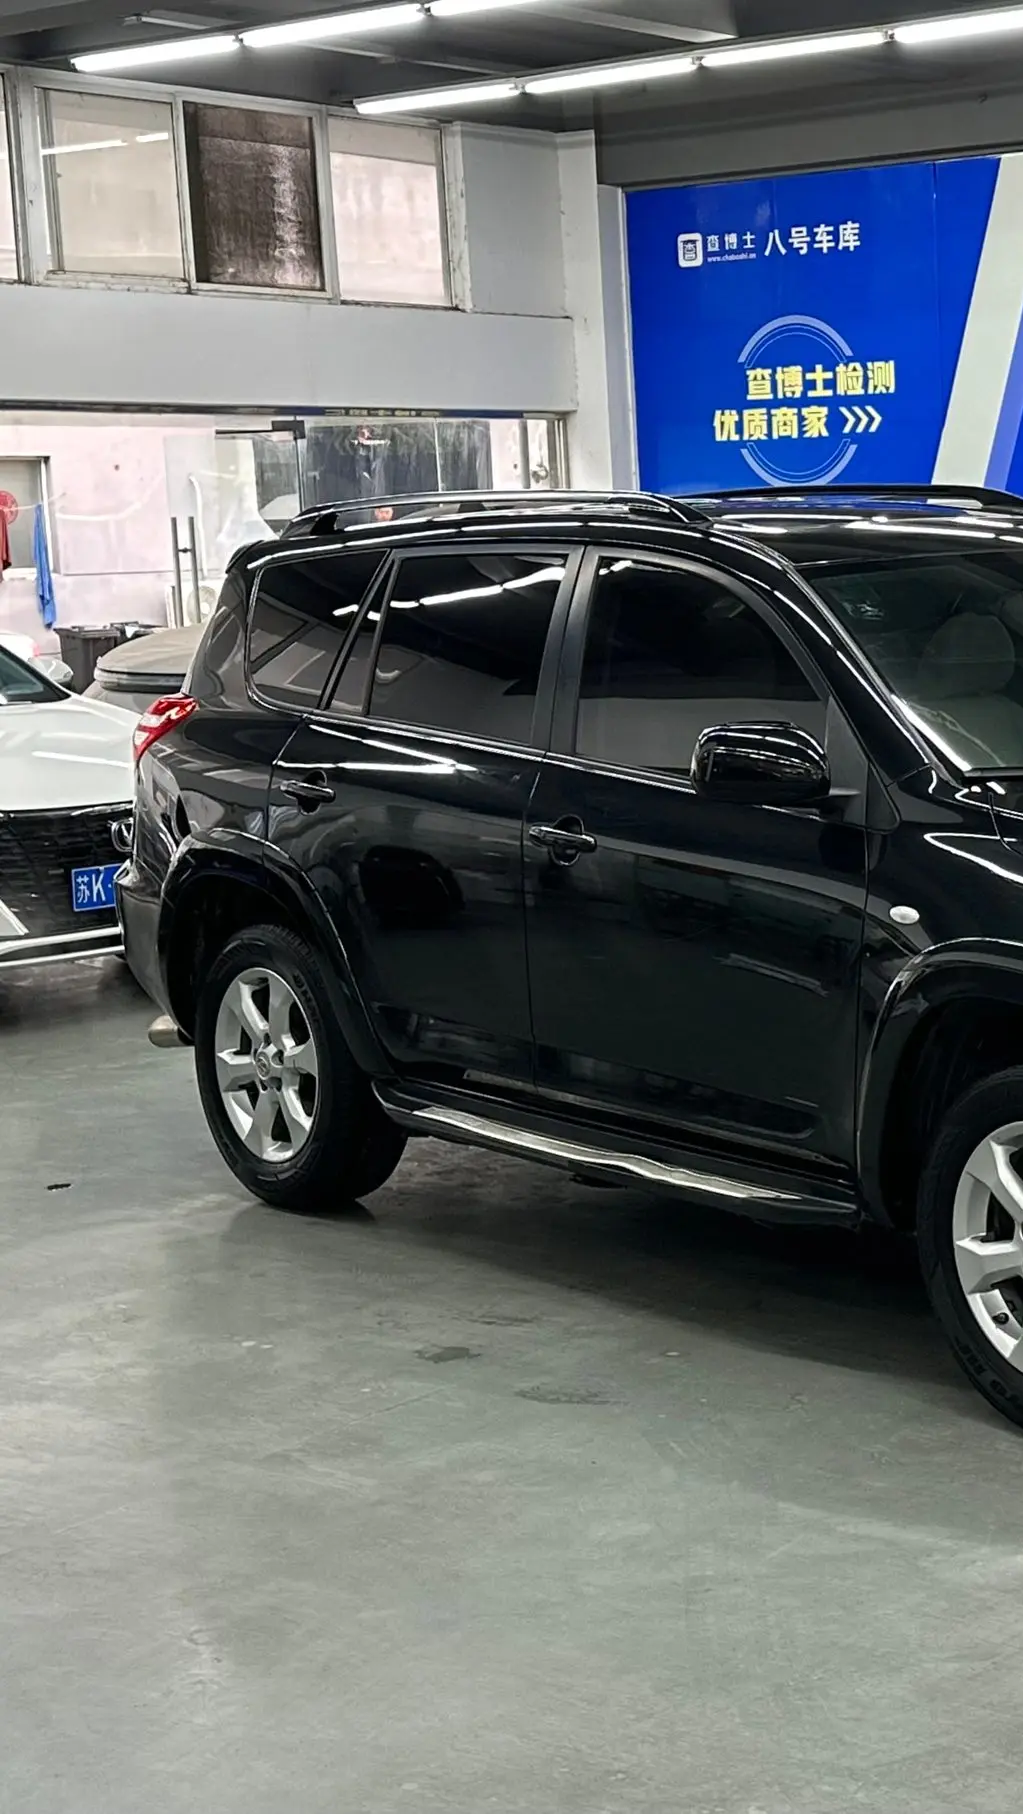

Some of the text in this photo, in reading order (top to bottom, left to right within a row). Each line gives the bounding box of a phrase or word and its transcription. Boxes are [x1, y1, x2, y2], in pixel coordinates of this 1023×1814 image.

[706, 220, 861, 257] 查博士 八号车库
[745, 360, 896, 401] 查博士检测
[713, 405, 830, 442] 优质商家
